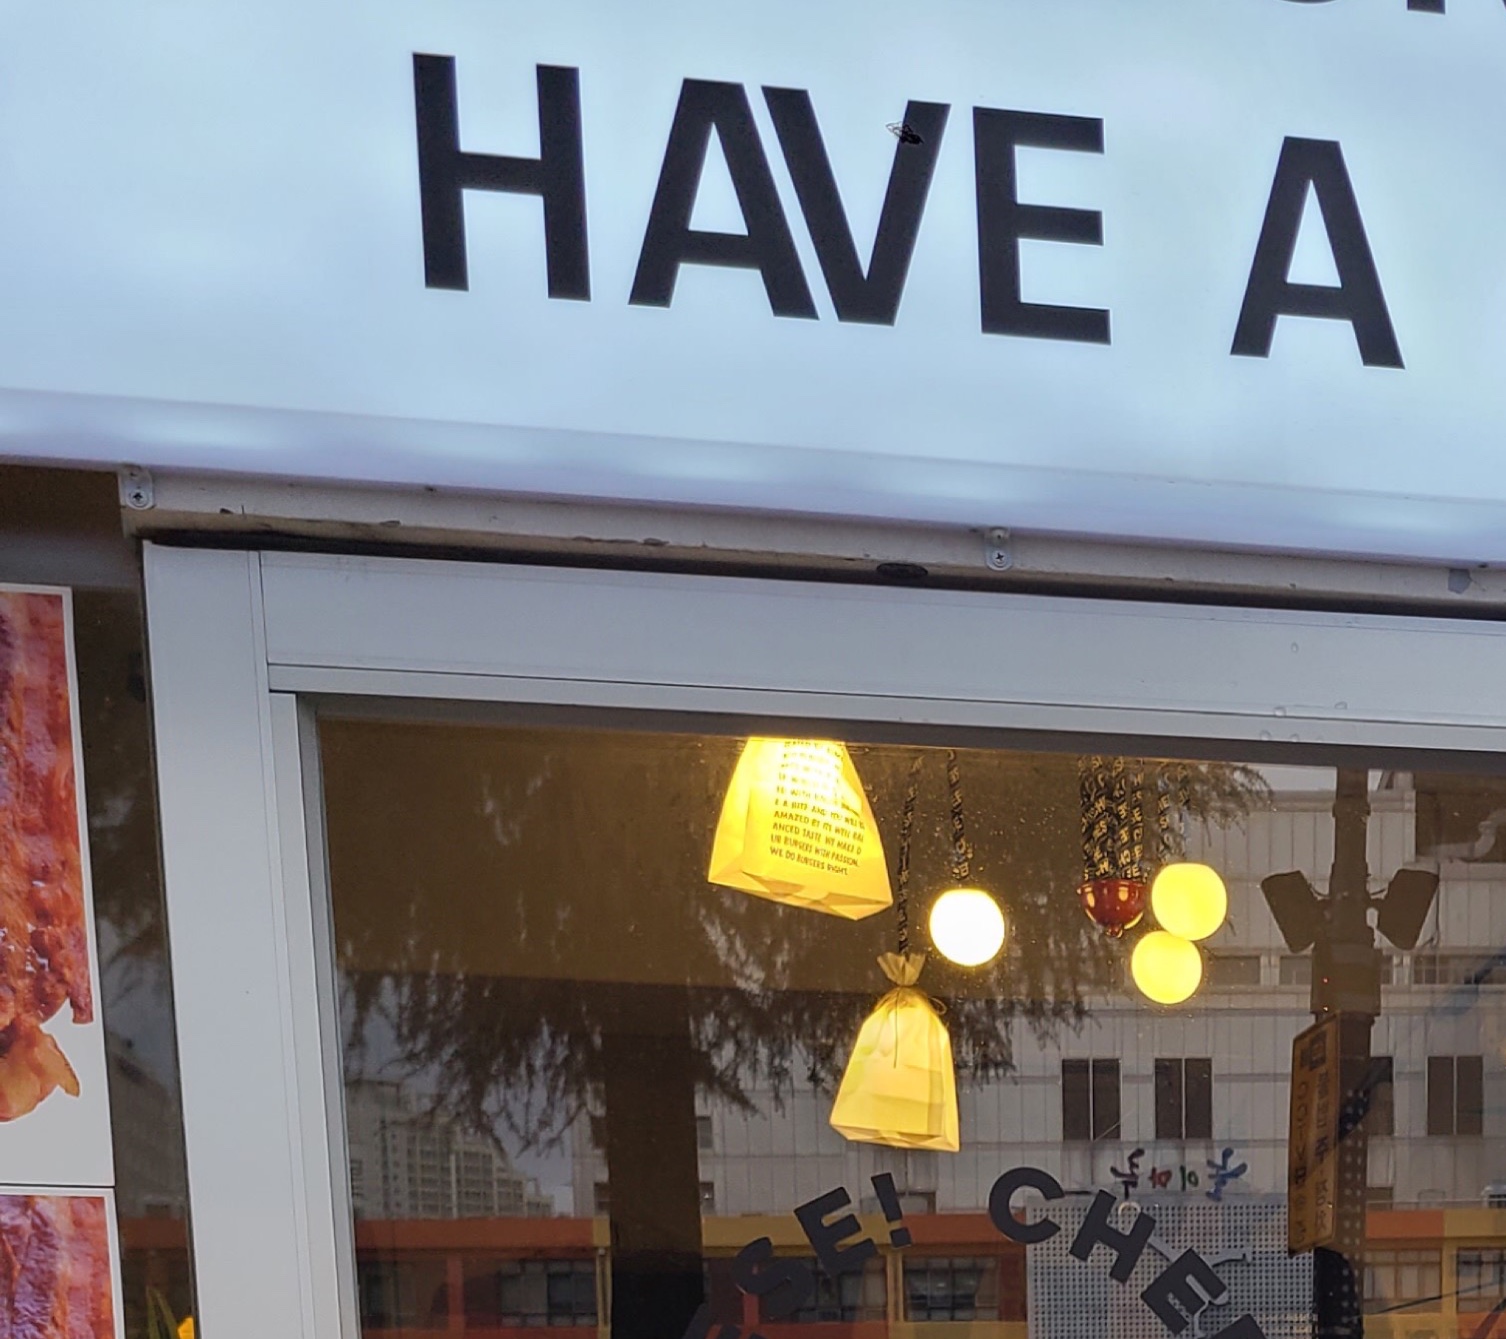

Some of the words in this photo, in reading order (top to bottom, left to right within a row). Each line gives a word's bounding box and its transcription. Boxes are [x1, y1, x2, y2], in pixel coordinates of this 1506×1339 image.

[412, 51, 1112, 345] HAVE
[1229, 135, 1405, 371] A
[773, 810, 809, 824] AMAZED
[772, 822, 800, 836] ANCED
[837, 840, 855, 853] MAKE
[783, 835, 814, 854] BURGERS
[814, 845, 831, 859] WITH
[769, 845, 784, 858] WE
[784, 849, 796, 862] DO
[796, 853, 825, 870] BURGERS
